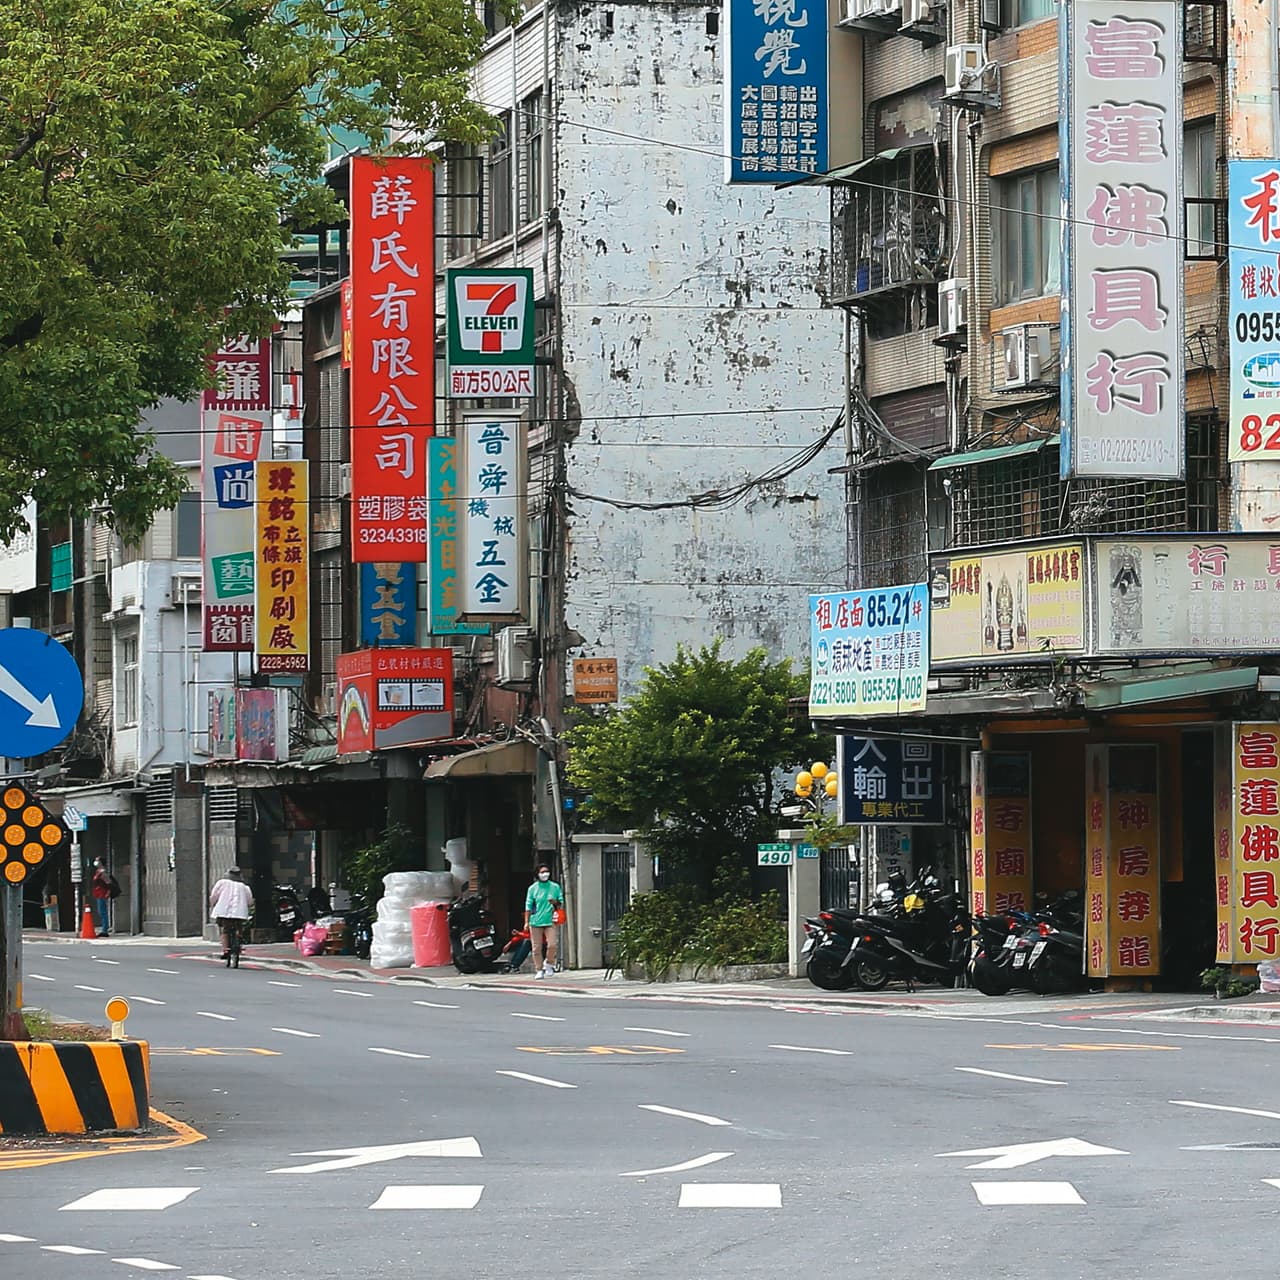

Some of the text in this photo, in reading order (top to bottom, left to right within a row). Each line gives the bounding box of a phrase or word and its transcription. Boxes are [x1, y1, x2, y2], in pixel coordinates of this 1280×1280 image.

[741, 85, 817, 101] 大圖輸出
[741, 103, 817, 119] 廣告招牌
[1085, 16, 1168, 417] 富蓮佛具行
[369, 175, 419, 479] 薛氏有限公司
[452, 370, 532, 394] 前方50公尺
[359, 495, 428, 521] 塑膠袋
[360, 528, 427, 545] 32343318
[270, 566, 297, 650] 印刷廠
[816, 598, 864, 631] 租店面
[261, 657, 306, 670] 2228-6962
[812, 681, 857, 705] 8221-5808
[861, 802, 925, 817] 專業代工
[1239, 731, 1280, 956] 富蓮佛具行
[760, 852, 791, 865] 490
